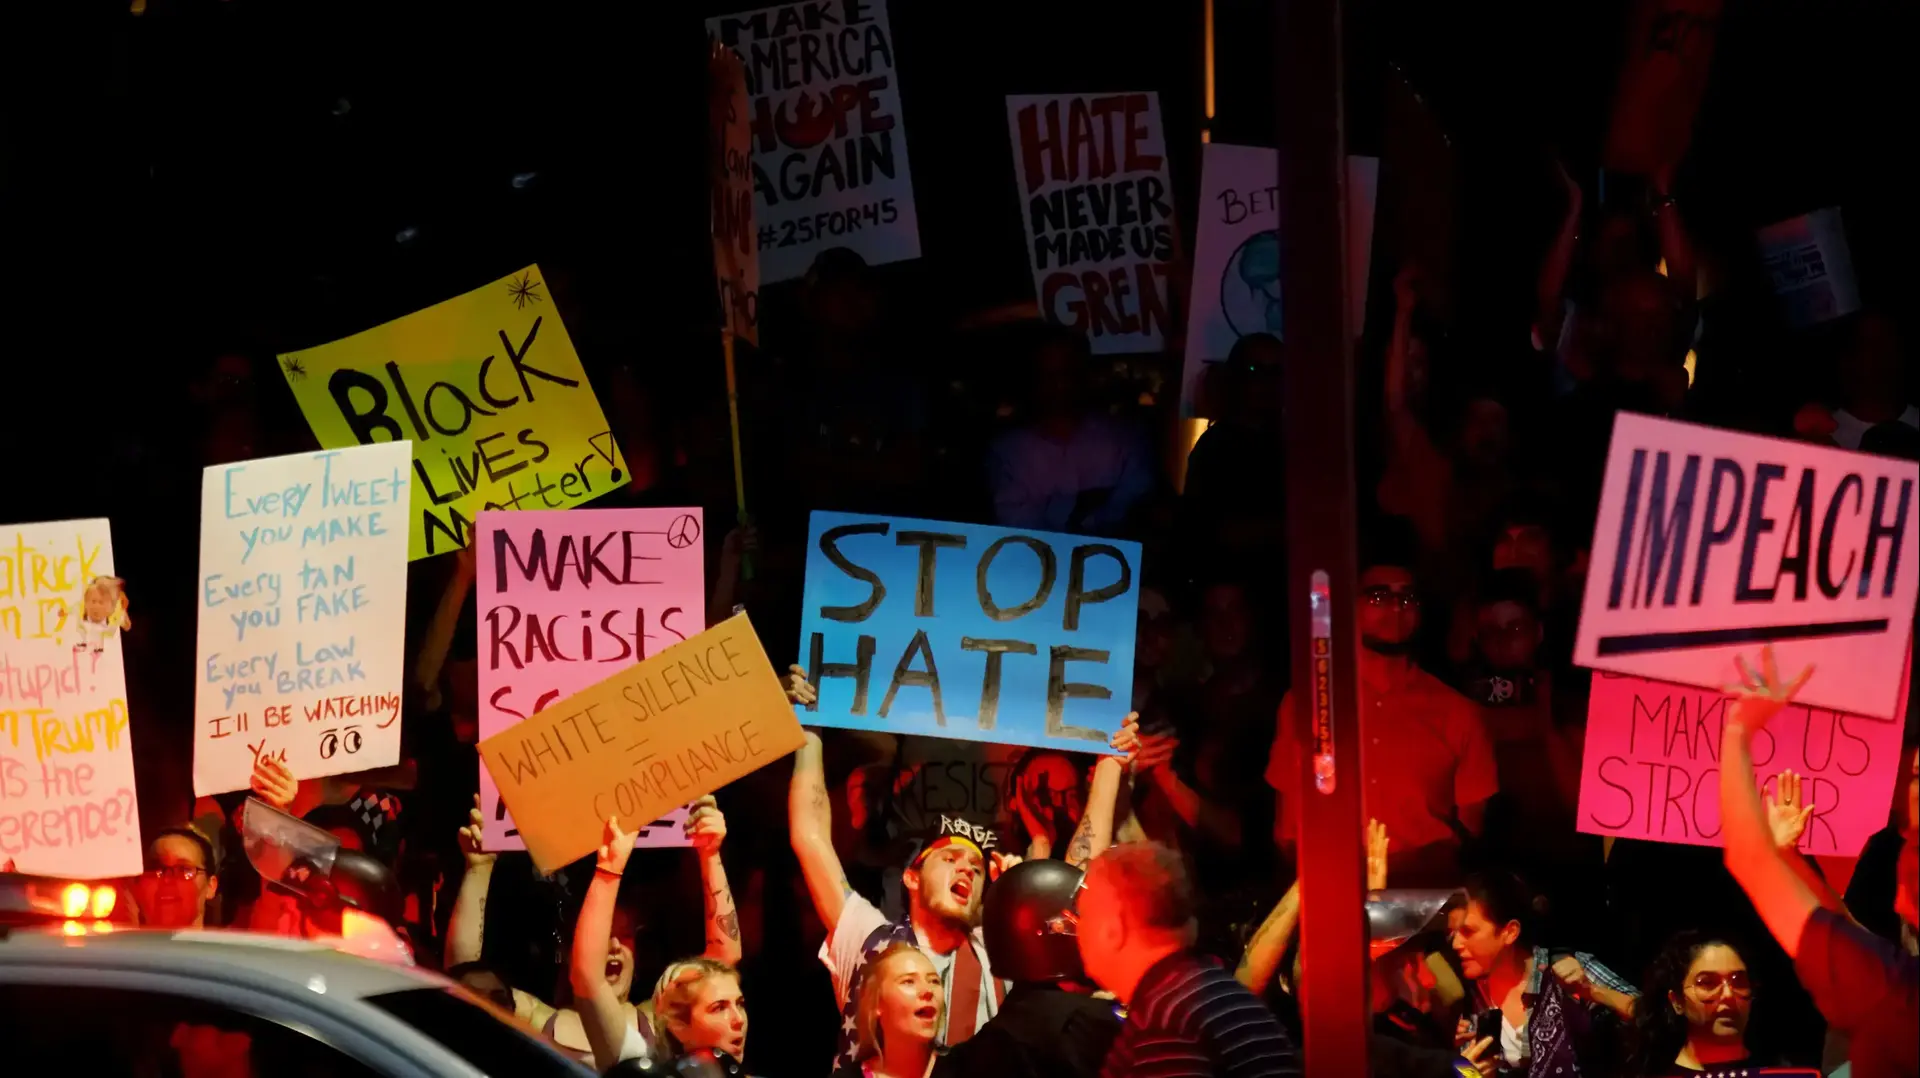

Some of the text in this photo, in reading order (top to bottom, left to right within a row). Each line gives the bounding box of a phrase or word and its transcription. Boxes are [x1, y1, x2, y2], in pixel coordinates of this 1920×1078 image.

[721, 0, 876, 47] MAKE
[1018, 94, 1163, 193] HATE
[1030, 177, 1172, 234] NEVER
[1035, 225, 1173, 270] MADE US
[1606, 449, 1912, 611] IMPEACH
[493, 528, 667, 593] MAKE
[820, 522, 1132, 632] STOP
[296, 584, 370, 624] FAKE
[0, 647, 100, 706] tupid?
[277, 660, 366, 694] BREAK
[805, 628, 1113, 743] HATE
[264, 704, 292, 728] BE
[499, 703, 616, 786] WHITE
[622, 636, 750, 722] SILENCE
[593, 720, 765, 824] COMPLIANCE
[901, 760, 1015, 815] ESIST
